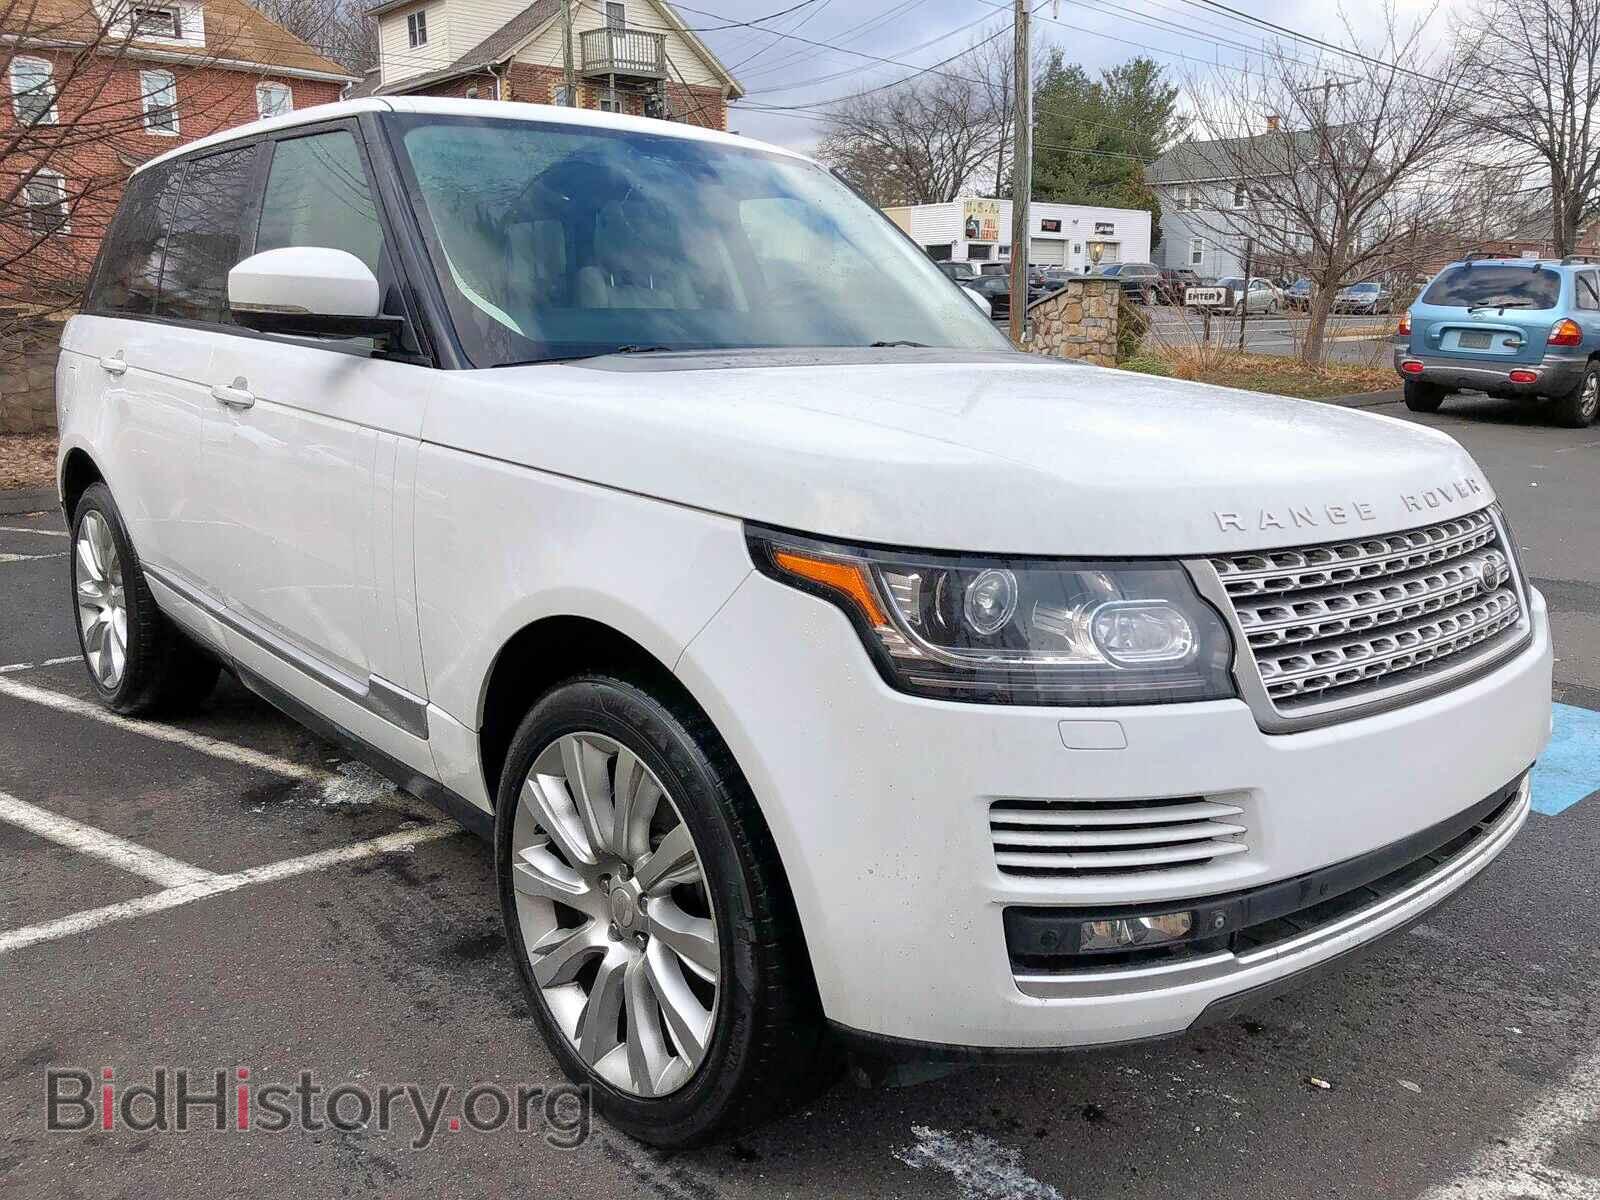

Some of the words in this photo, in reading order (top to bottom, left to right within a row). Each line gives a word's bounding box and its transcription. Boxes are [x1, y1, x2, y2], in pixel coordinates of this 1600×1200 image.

[1188, 292, 1216, 301] ENTER
[1214, 500, 1377, 532] RANGE
[1400, 478, 1481, 512] ROVER
